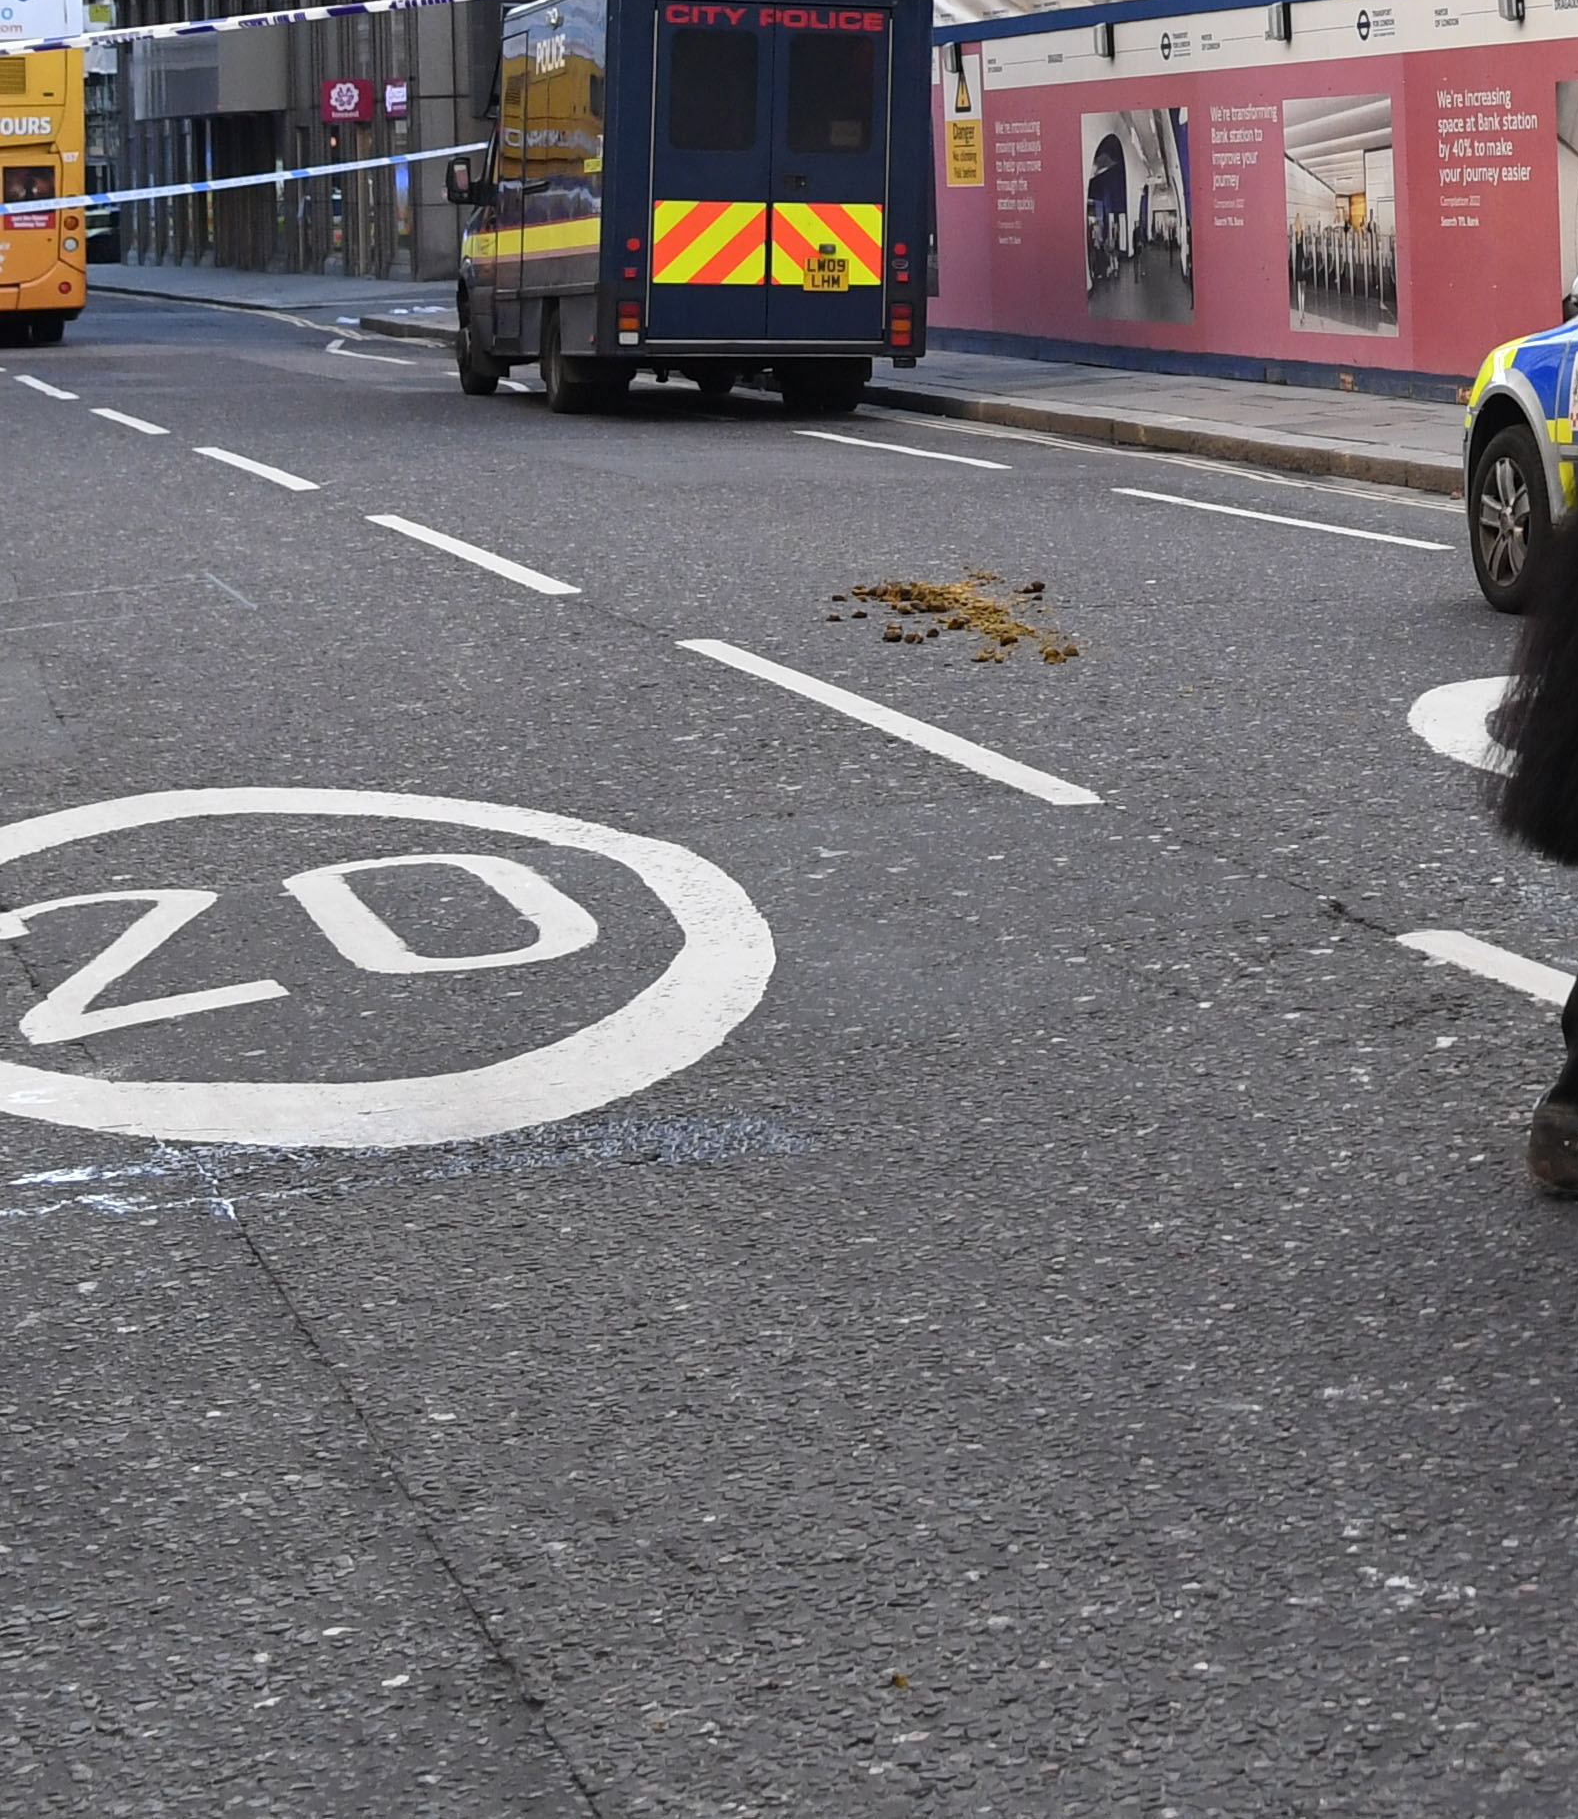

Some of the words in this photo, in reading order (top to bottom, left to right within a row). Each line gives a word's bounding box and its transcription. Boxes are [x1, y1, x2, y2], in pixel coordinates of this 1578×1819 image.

[665, 4, 748, 26] CITY
[759, 7, 885, 32] POLICE
[536, 33, 567, 76] POLICE
[1437, 88, 1463, 109] We're
[1464, 87, 1512, 110] increasing
[1210, 105, 1230, 122] We're
[1231, 103, 1278, 123] transforming
[1438, 118, 1464, 137] space
[1465, 115, 1476, 132] at
[1477, 112, 1501, 131] Bank
[1502, 112, 1538, 131] station
[0, 116, 52, 136] OURS
[953, 122, 976, 145] Danger
[1211, 127, 1228, 144] Bank
[1229, 126, 1254, 143] station
[1254, 127, 1263, 142] to
[1212, 151, 1241, 169] improve
[1242, 150, 1259, 169] your
[1438, 139, 1450, 162] by
[1451, 138, 1473, 158] 40%
[1474, 140, 1485, 157] to
[1486, 137, 1513, 157] make
[1212, 171, 1240, 191] journey
[1439, 167, 1461, 186] your
[1461, 164, 1500, 186] journey
[1501, 162, 1532, 182] easier
[807, 258, 846, 273] LW09
[811, 274, 841, 288] LHM
[0, 853, 600, 1044] 20
